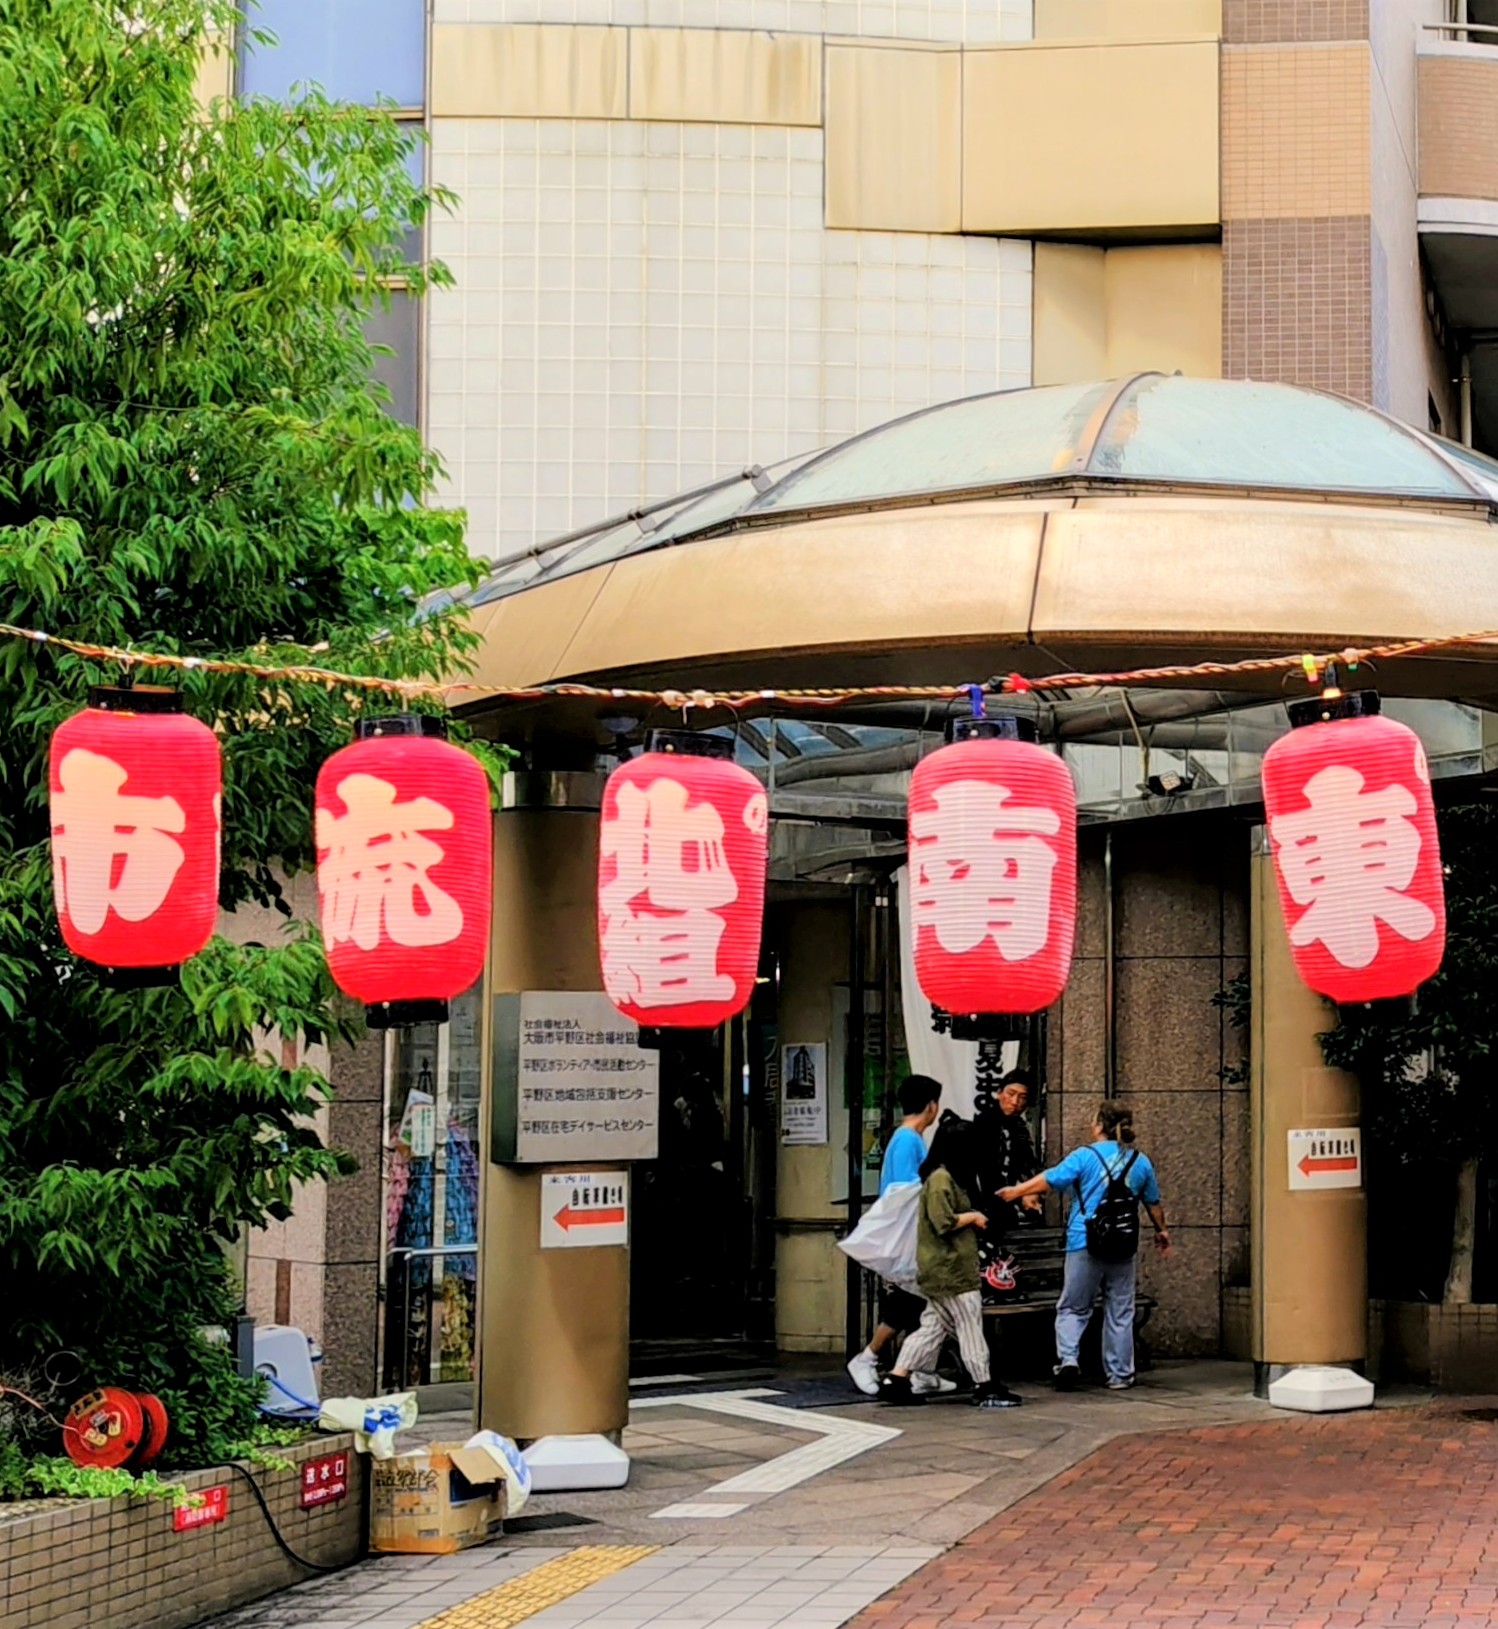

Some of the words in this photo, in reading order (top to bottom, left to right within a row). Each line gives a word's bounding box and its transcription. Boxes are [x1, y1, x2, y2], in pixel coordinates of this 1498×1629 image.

[50, 748, 187, 936] 市
[316, 773, 465, 952] 流
[909, 779, 1062, 962] 南
[1271, 766, 1437, 969] 東
[524, 1019, 581, 1030] 社会福祉法人
[524, 1031, 640, 1045] 大阪市平野区社会福祉協
[522, 1119, 655, 1134] 平野区在宅デイサービスセンター
[523, 1087, 655, 1101] 平野区地域包括支援センター
